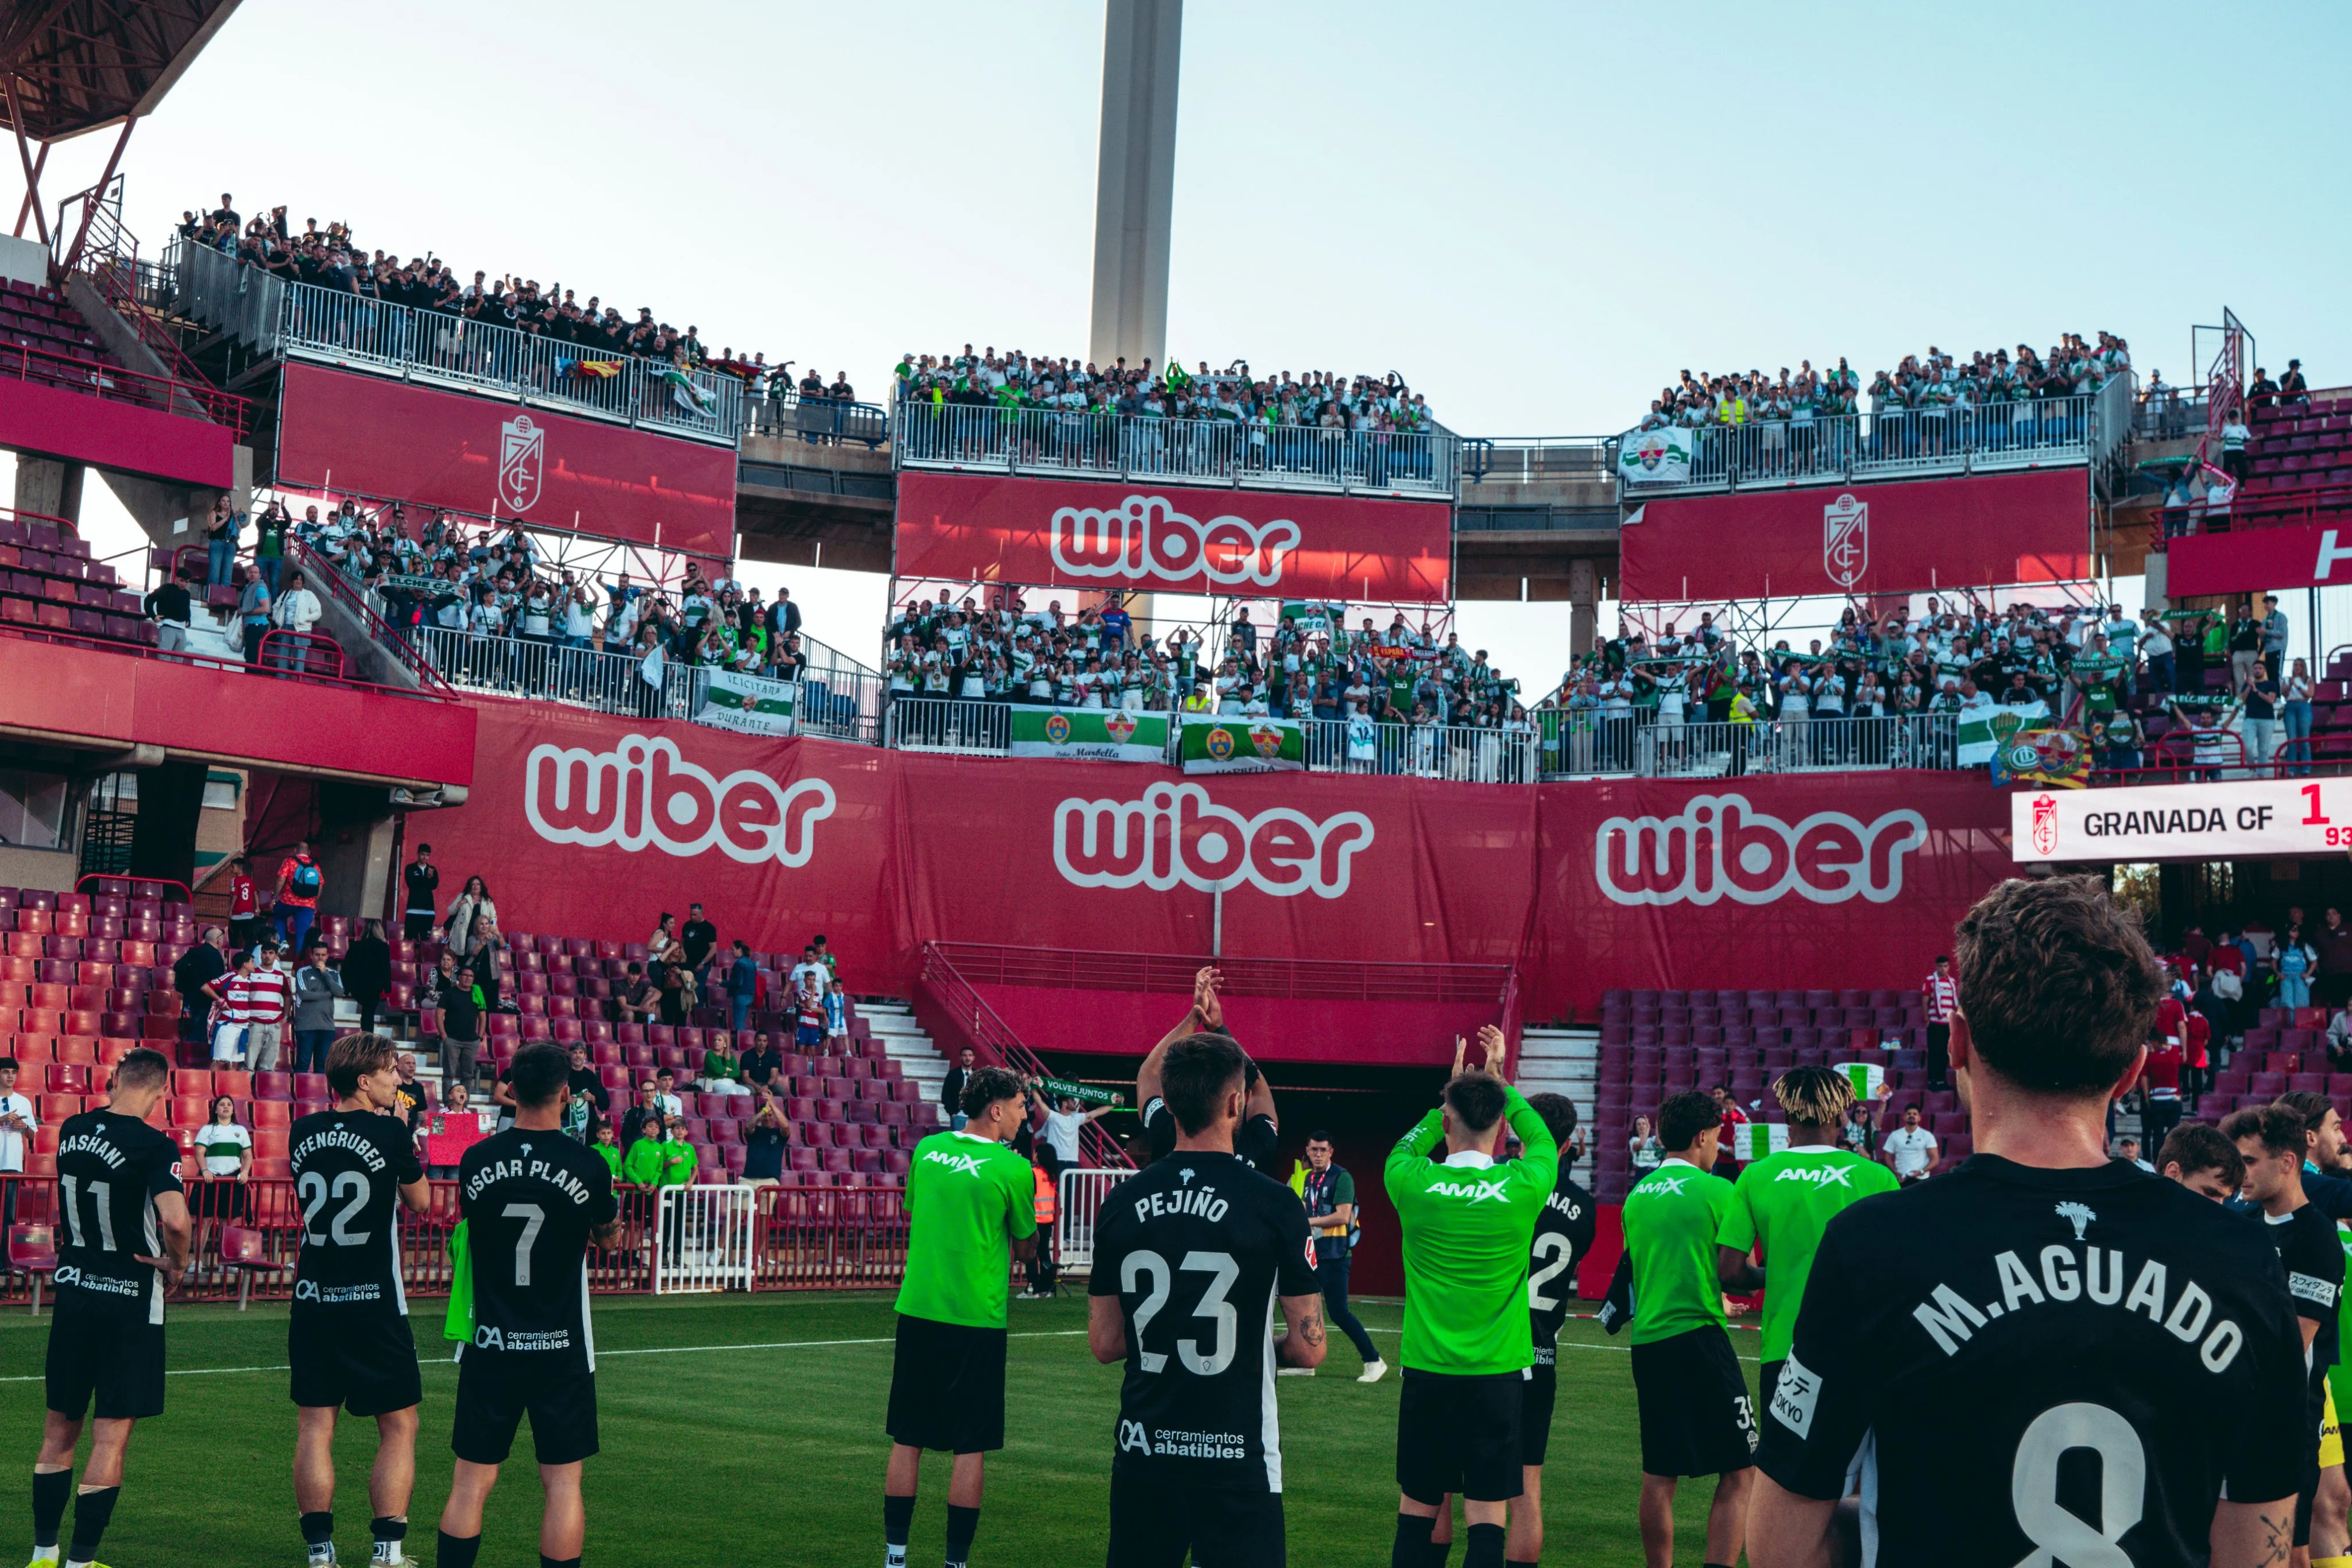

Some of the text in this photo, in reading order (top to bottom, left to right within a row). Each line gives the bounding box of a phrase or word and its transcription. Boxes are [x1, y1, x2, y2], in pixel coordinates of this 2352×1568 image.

[1051, 495, 1301, 586] wiber
[389, 577, 455, 592] ELCHE C.F.
[717, 712, 771, 730] DURANTE
[1072, 748, 1119, 758] Marbella
[525, 734, 836, 868] wiber
[2084, 784, 2330, 836] GRANADA CF 1
[1054, 781, 1374, 898] wiber
[1596, 793, 1928, 905] wiber
[1047, 1081, 1077, 1093] VOLVER
[1078, 1087, 1108, 1099] JUNTOS
[574, 1097, 587, 1121] ELC
[59, 1135, 126, 1170] RASHANI
[290, 1131, 386, 1174] AFFENGRUBER
[467, 1159, 590, 1205] ÓSCAR PLANO
[61, 1174, 117, 1250] 11
[296, 1171, 370, 1246] 22
[1135, 1186, 1229, 1222] PEJIÑO
[501, 1204, 545, 1286] 7
[81, 1280, 139, 1296] abatibles
[323, 1283, 380, 1293] cerramientos
[323, 1291, 381, 1302] abatibles
[1121, 1250, 1240, 1376] 23
[1913, 1245, 2243, 1373] M.AGUADO
[506, 1338, 570, 1350] abatibles
[507, 1329, 568, 1340] cerramientos
[1154, 1440, 1245, 1459] abatibles
[1155, 1429, 1244, 1445] cerramientos
